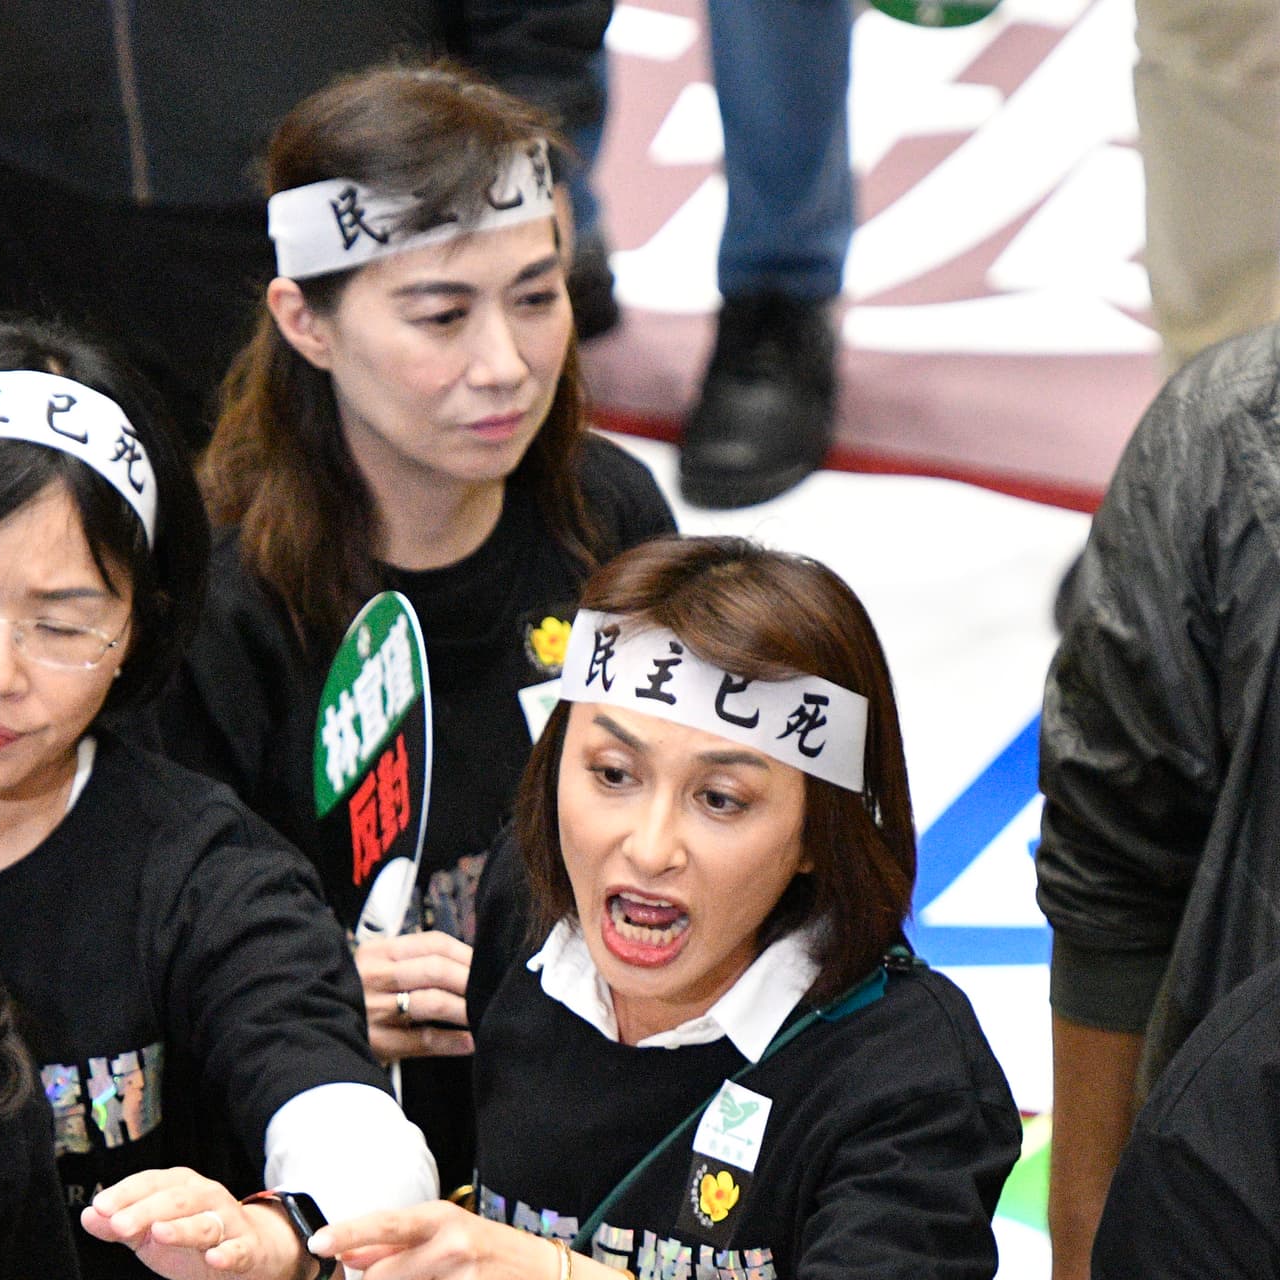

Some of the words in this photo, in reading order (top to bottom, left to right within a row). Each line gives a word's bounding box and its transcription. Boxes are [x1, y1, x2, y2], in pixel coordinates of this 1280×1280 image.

[586, 622, 829, 758] 民主已死
[349, 732, 411, 887] 反對
